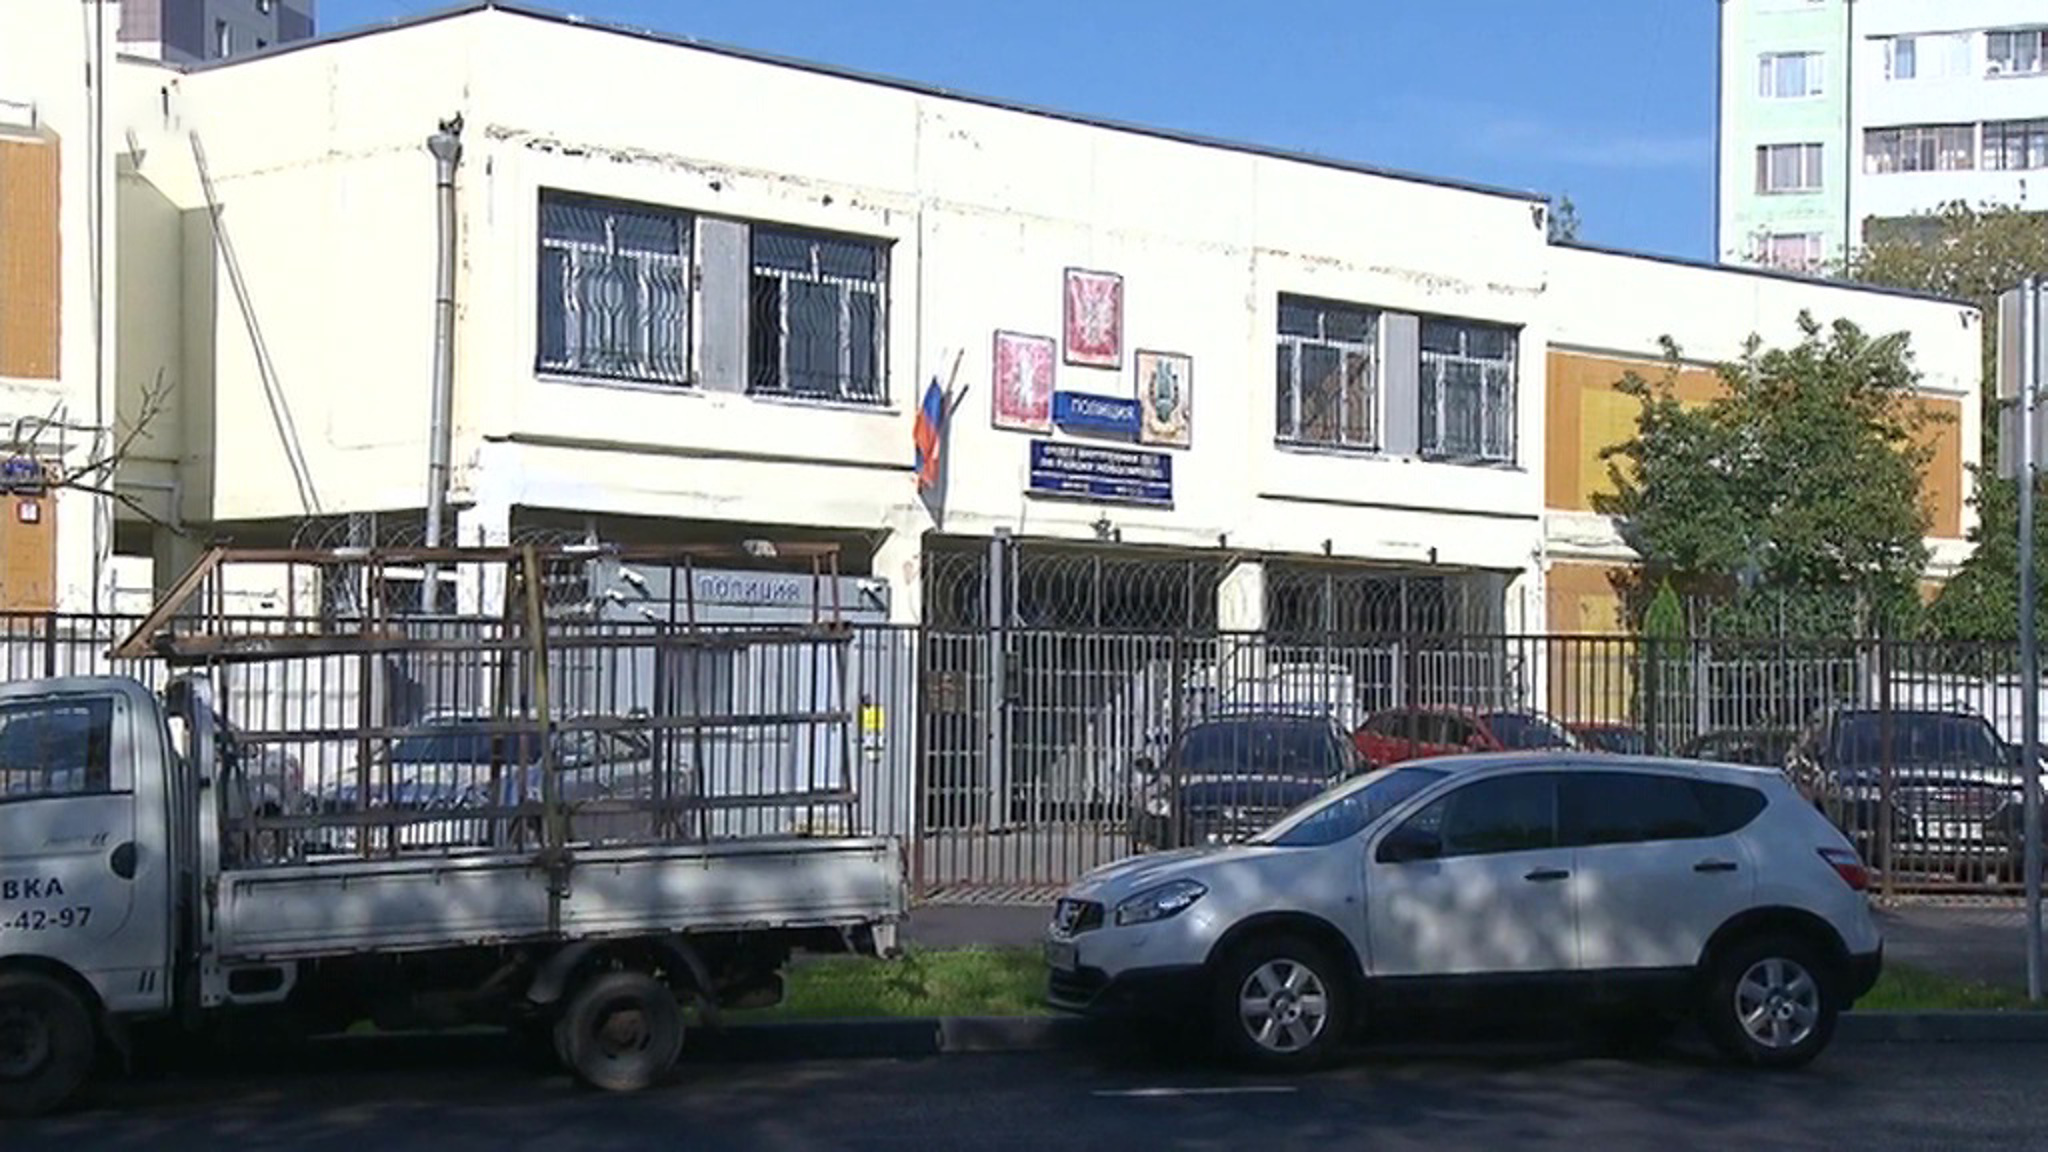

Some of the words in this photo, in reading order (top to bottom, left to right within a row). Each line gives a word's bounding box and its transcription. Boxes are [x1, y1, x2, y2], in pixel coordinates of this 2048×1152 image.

[699, 575, 800, 602] ПОЛИЦИЯ
[2, 877, 64, 899] ВКА
[0, 906, 92, 931] -42-97
